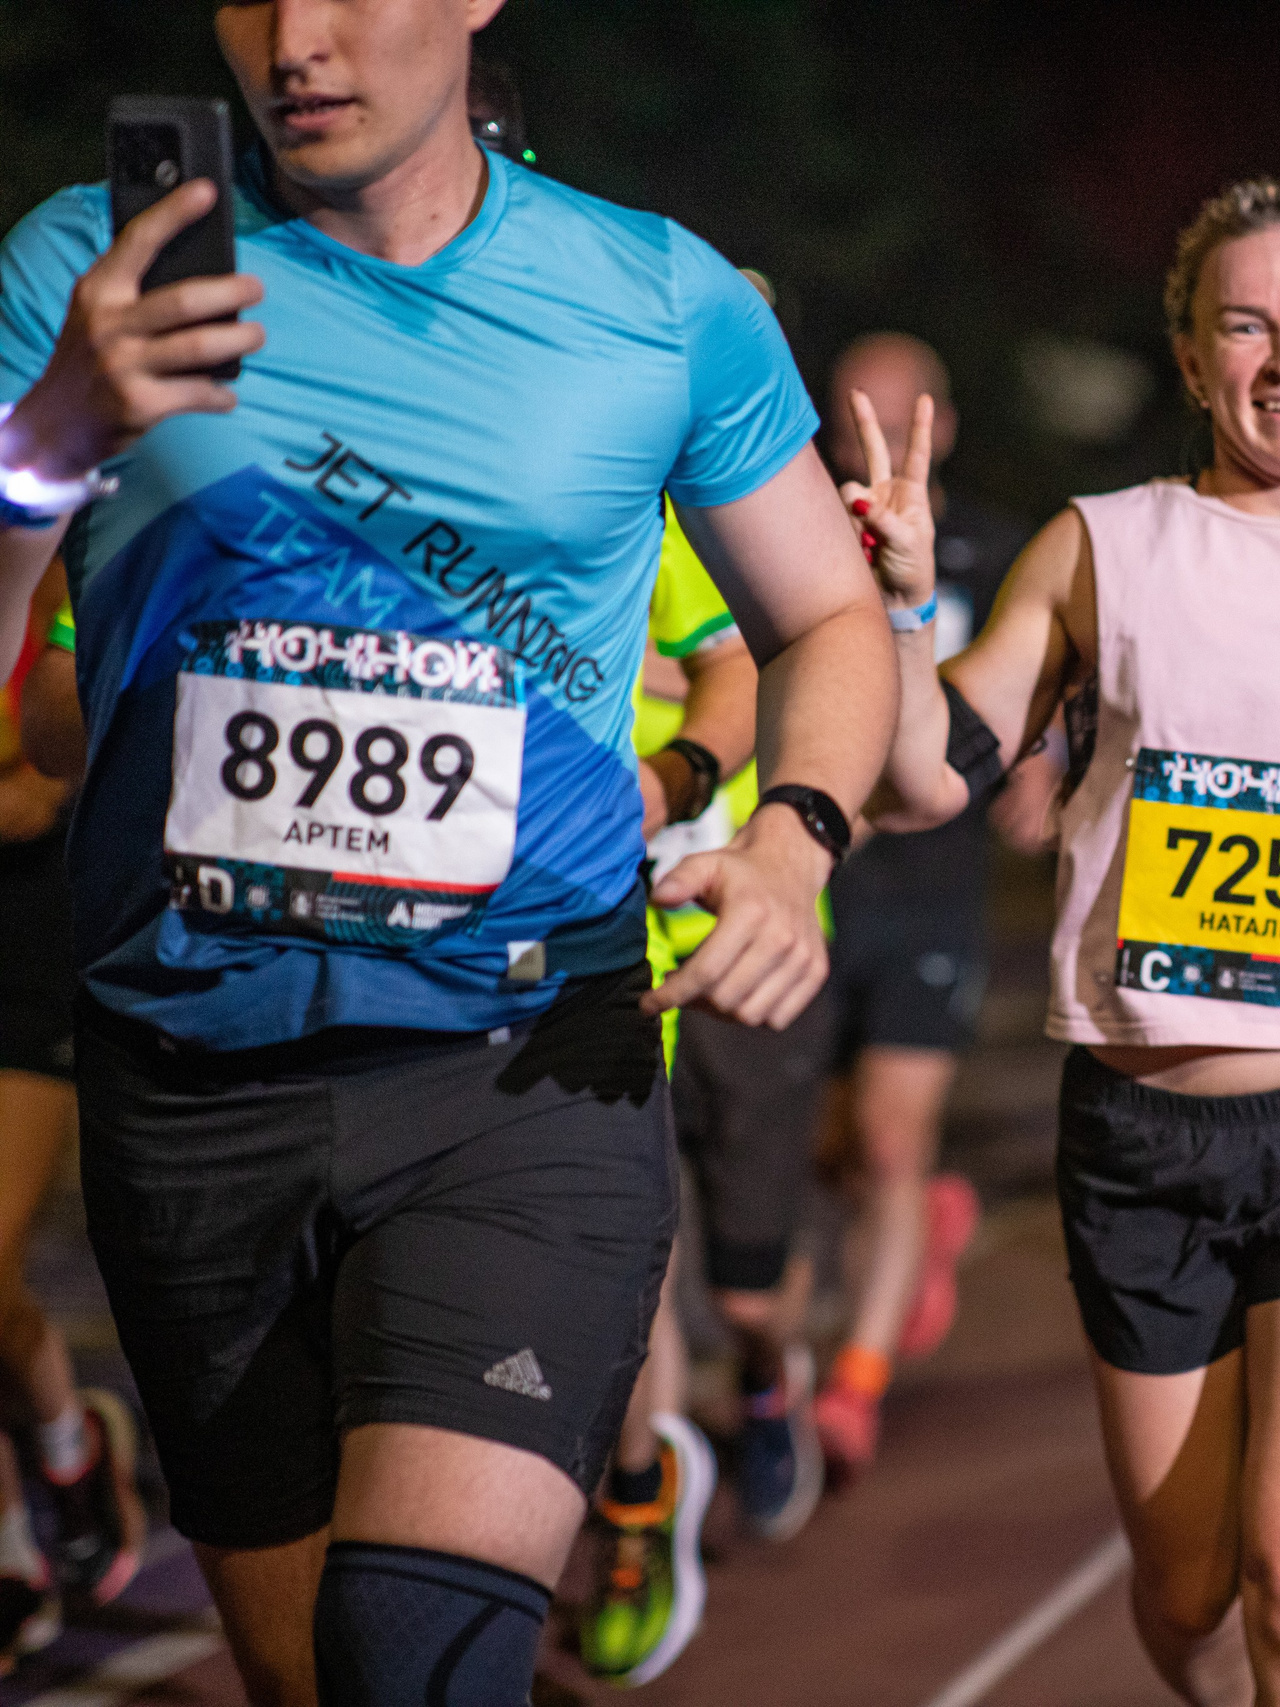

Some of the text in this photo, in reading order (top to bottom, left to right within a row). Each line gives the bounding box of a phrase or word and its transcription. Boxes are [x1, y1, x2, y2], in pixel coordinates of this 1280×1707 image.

[241, 490, 404, 630] TEAM
[284, 432, 605, 702] JET RUNNING
[226, 620, 503, 692] НОЧНОЙ
[220, 710, 476, 822] 8989
[283, 820, 391, 855] АРТЕМ
[197, 864, 235, 914] D
[1139, 949, 1173, 992] C
